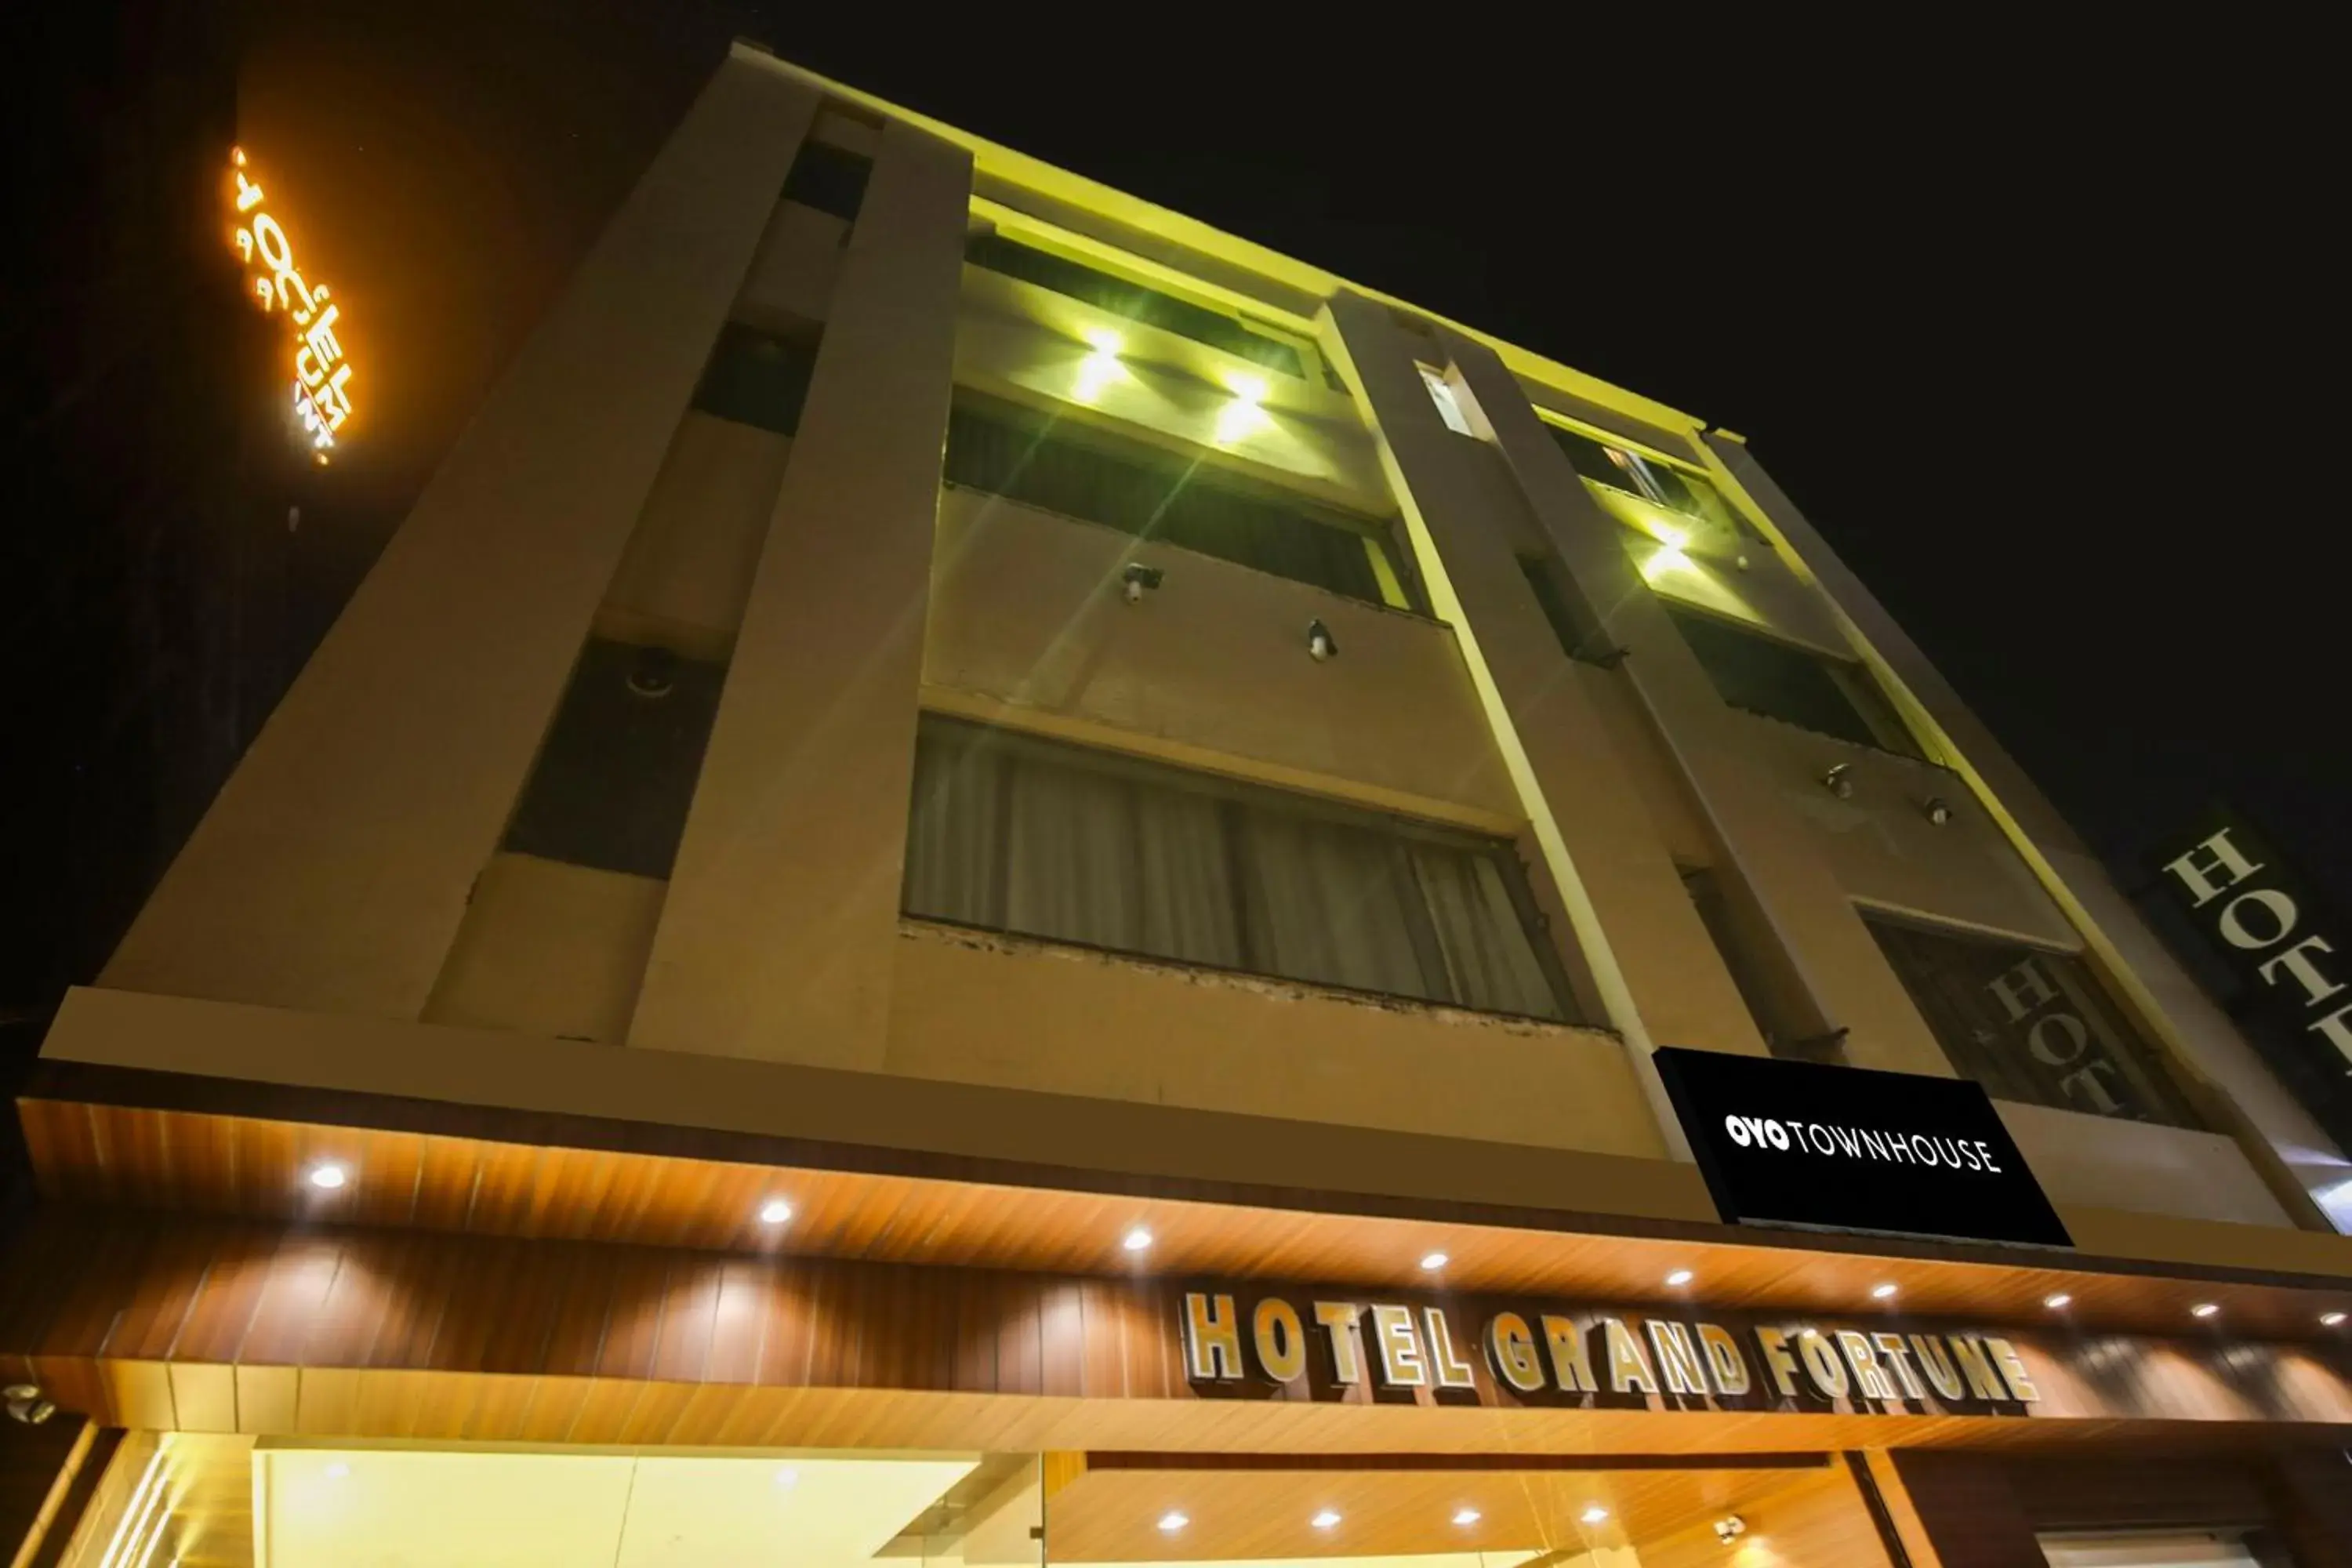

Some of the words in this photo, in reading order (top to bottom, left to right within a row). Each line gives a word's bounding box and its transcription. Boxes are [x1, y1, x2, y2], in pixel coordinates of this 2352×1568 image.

[1725, 1115, 1790, 1151] OYO
[1787, 1120, 2002, 1174] TOWNHOUSE
[1185, 1293, 1475, 1388] HOTEL
[1485, 1311, 1750, 1396] GRAND
[1753, 1325, 2040, 1402] FORTUNE
